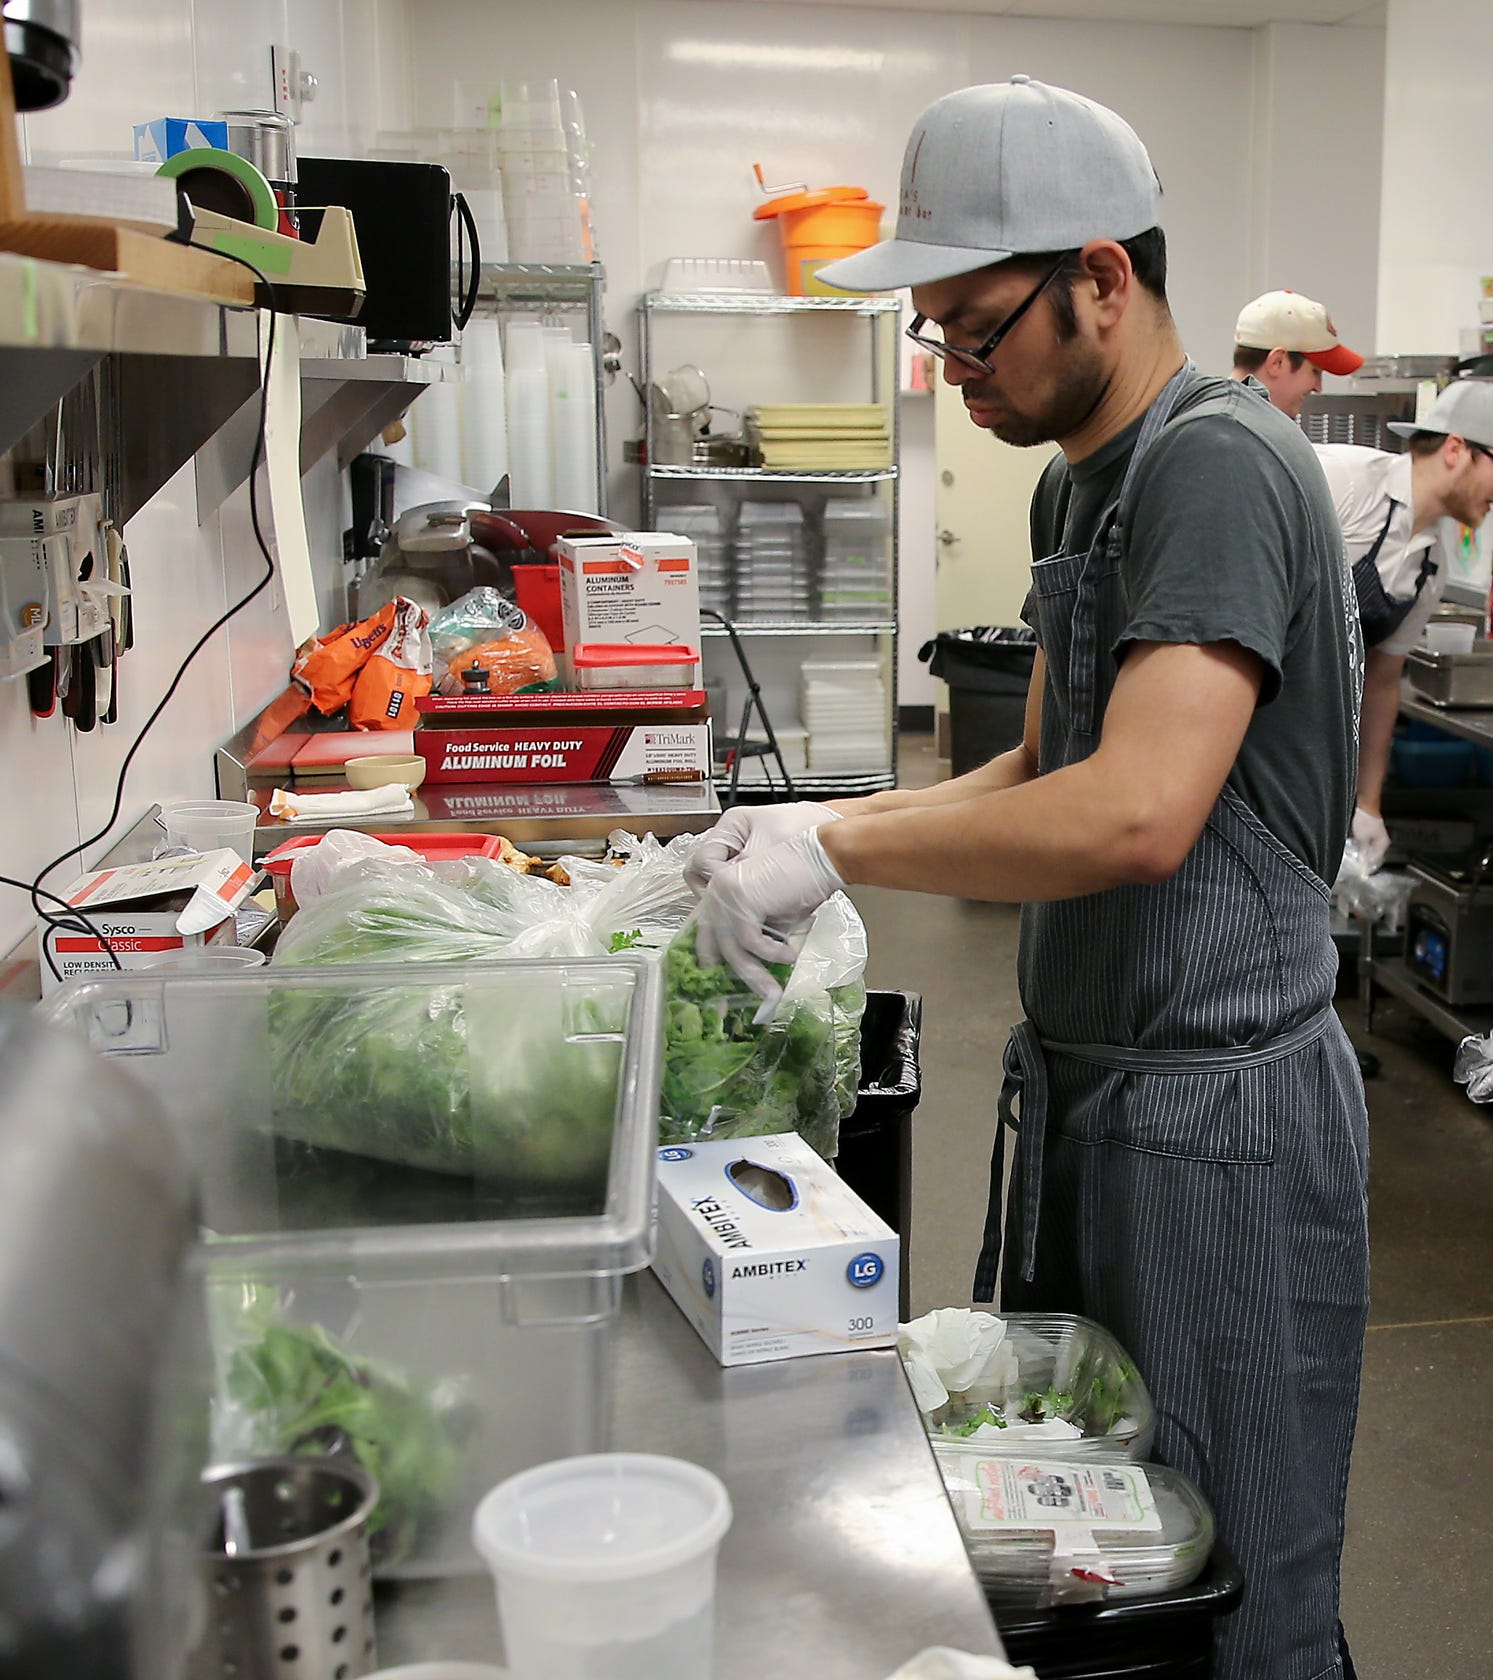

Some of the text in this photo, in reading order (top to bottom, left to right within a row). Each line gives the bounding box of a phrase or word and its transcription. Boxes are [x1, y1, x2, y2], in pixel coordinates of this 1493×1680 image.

[586, 576, 629, 584] ALUMINUM
[586, 584, 635, 592] CONTAINERS
[657, 733, 696, 744] TriMark
[446, 741, 583, 753] Food Service HEAVY DUTY
[440, 754, 567, 770] ALUMINUM FOIL
[102, 924, 136, 936] Sysco
[692, 1195, 753, 1250] AMBITEX
[732, 1259, 808, 1279] AMBITEX
[854, 1262, 877, 1278] LG
[849, 1317, 873, 1331] 300
